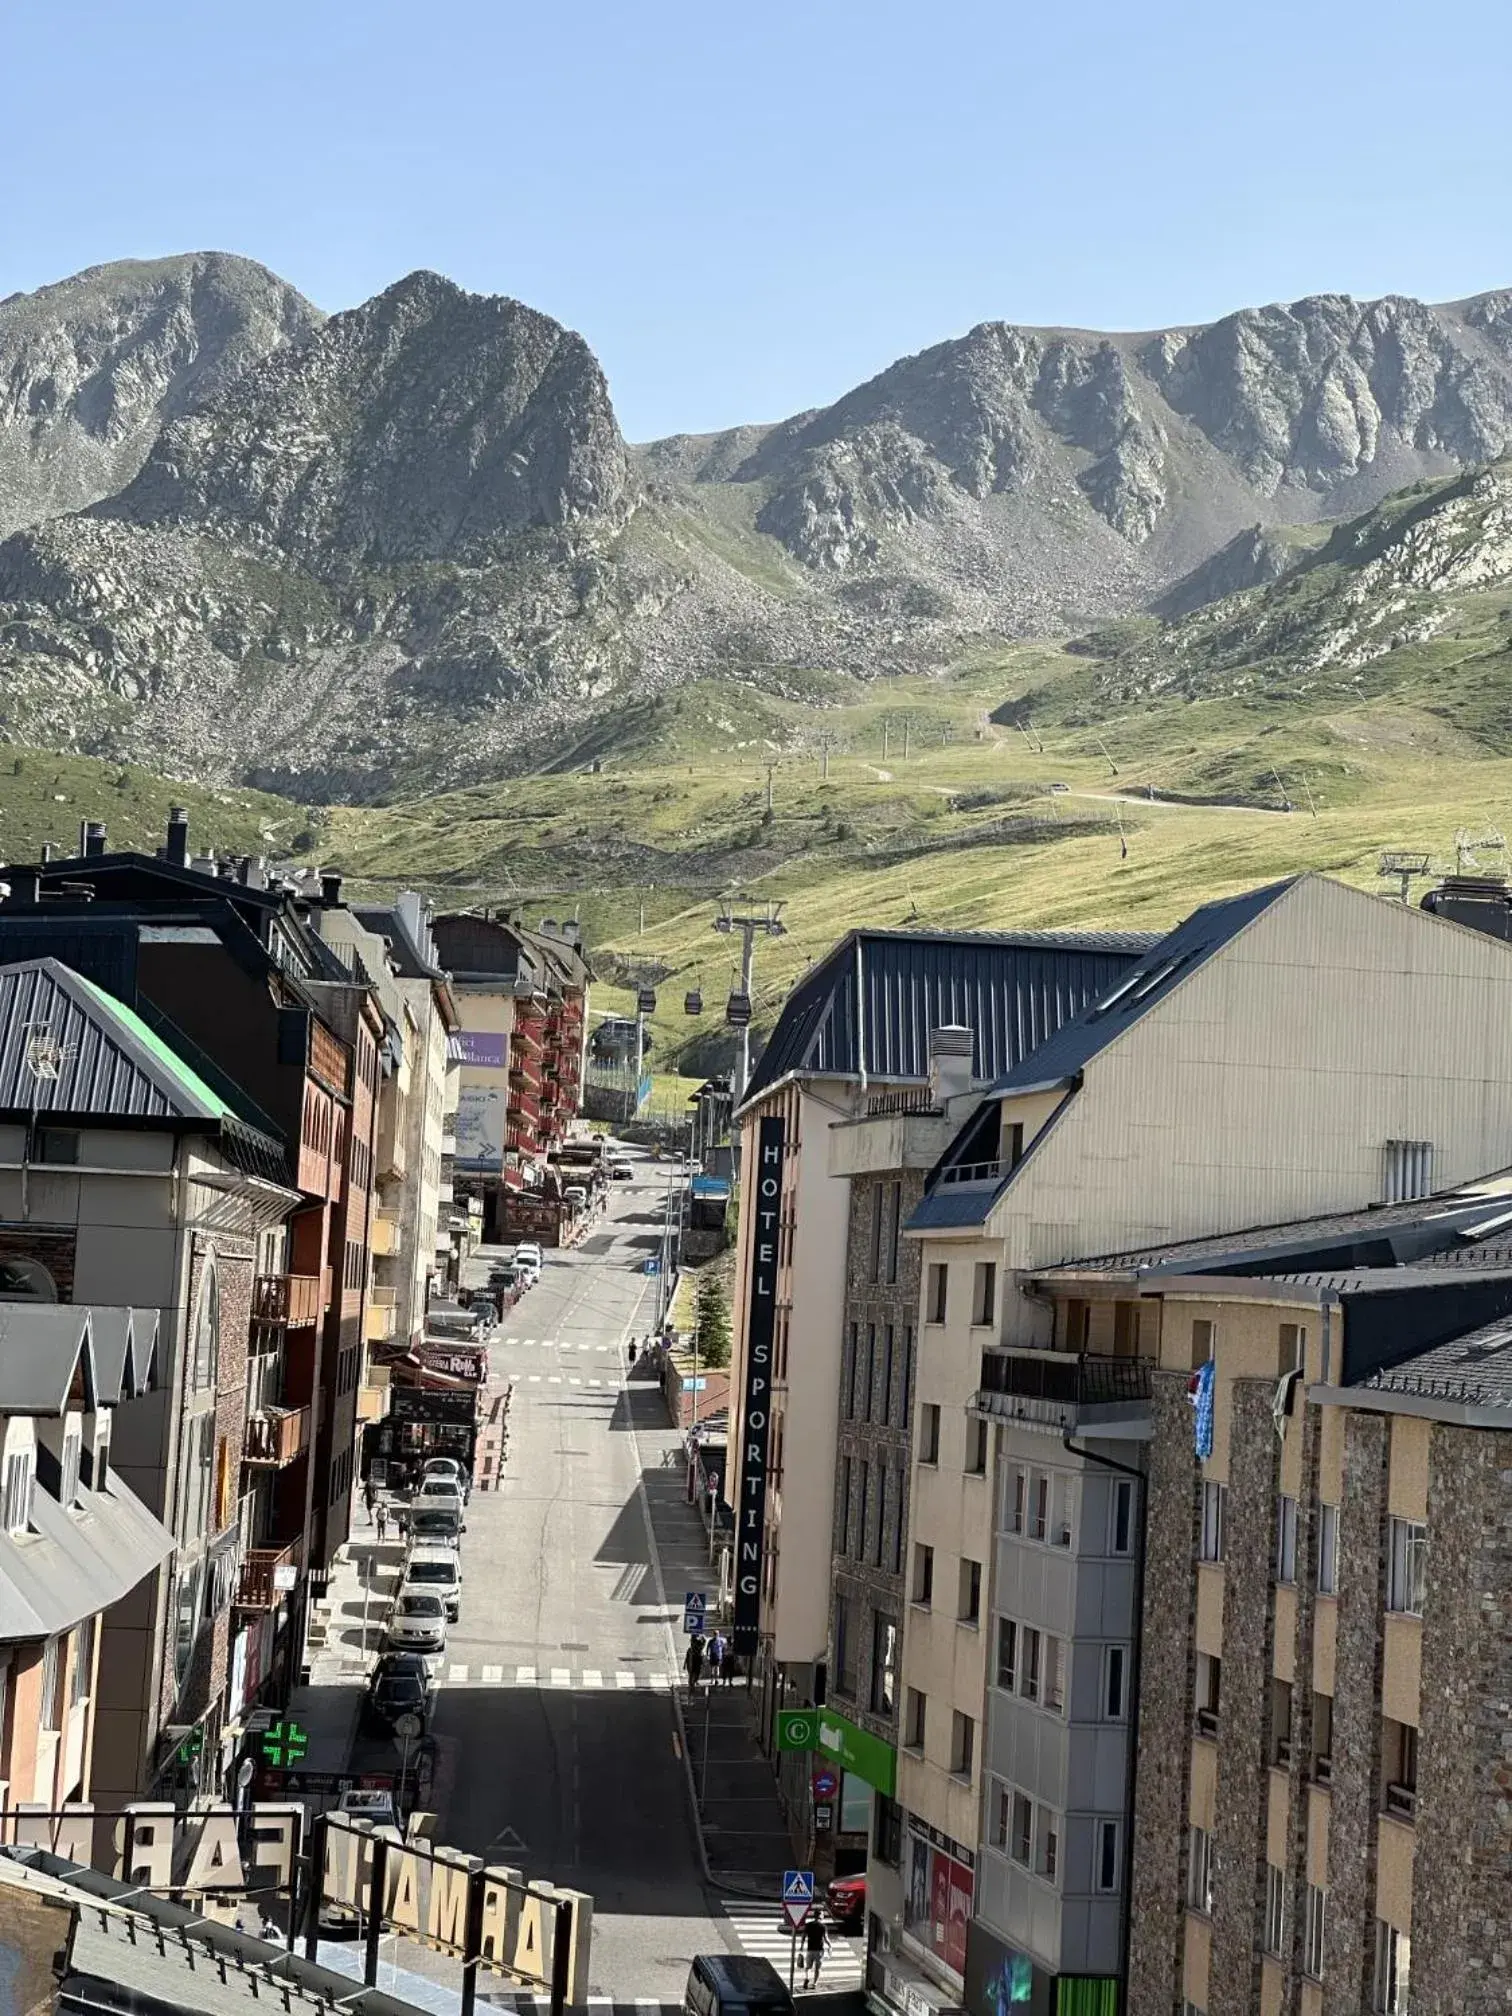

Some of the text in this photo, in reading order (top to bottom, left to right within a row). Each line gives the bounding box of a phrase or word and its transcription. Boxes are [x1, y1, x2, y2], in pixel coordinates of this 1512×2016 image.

[647, 1261, 655, 1271] P
[740, 1145, 779, 1595] HOTEL SPORTING
[686, 1616, 698, 1631] P
